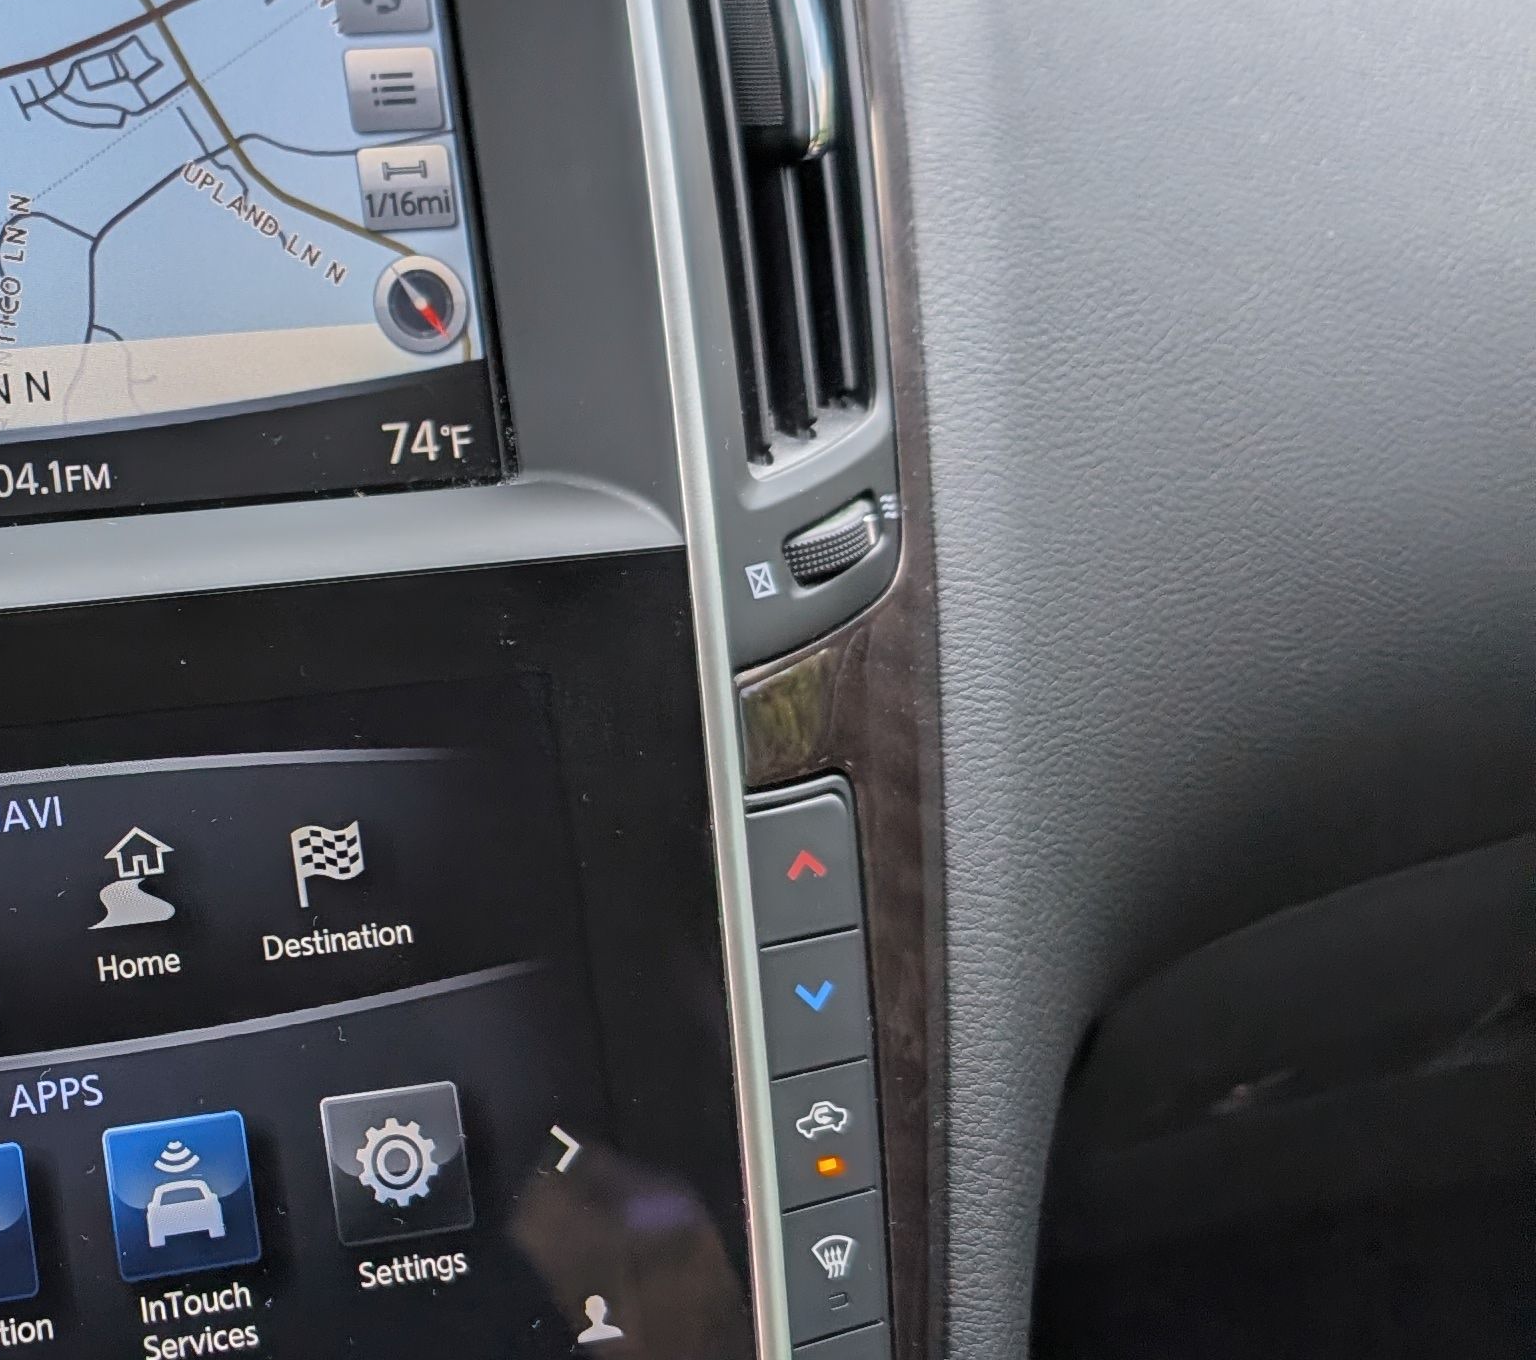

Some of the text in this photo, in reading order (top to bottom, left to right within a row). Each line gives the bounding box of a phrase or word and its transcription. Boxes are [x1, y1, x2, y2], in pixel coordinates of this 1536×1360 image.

[9, 194, 32, 215] N
[364, 189, 452, 218] 1/16mi
[183, 161, 346, 286] UPLAND LN N
[4, 225, 28, 262] LN
[24, 370, 52, 403] N
[381, 420, 472, 465] 74°F
[262, 922, 414, 961] Destination
[97, 953, 181, 982] Home
[10, 1074, 104, 1118] APPS
[358, 1252, 468, 1289] Settings
[140, 1281, 252, 1324] InTouch
